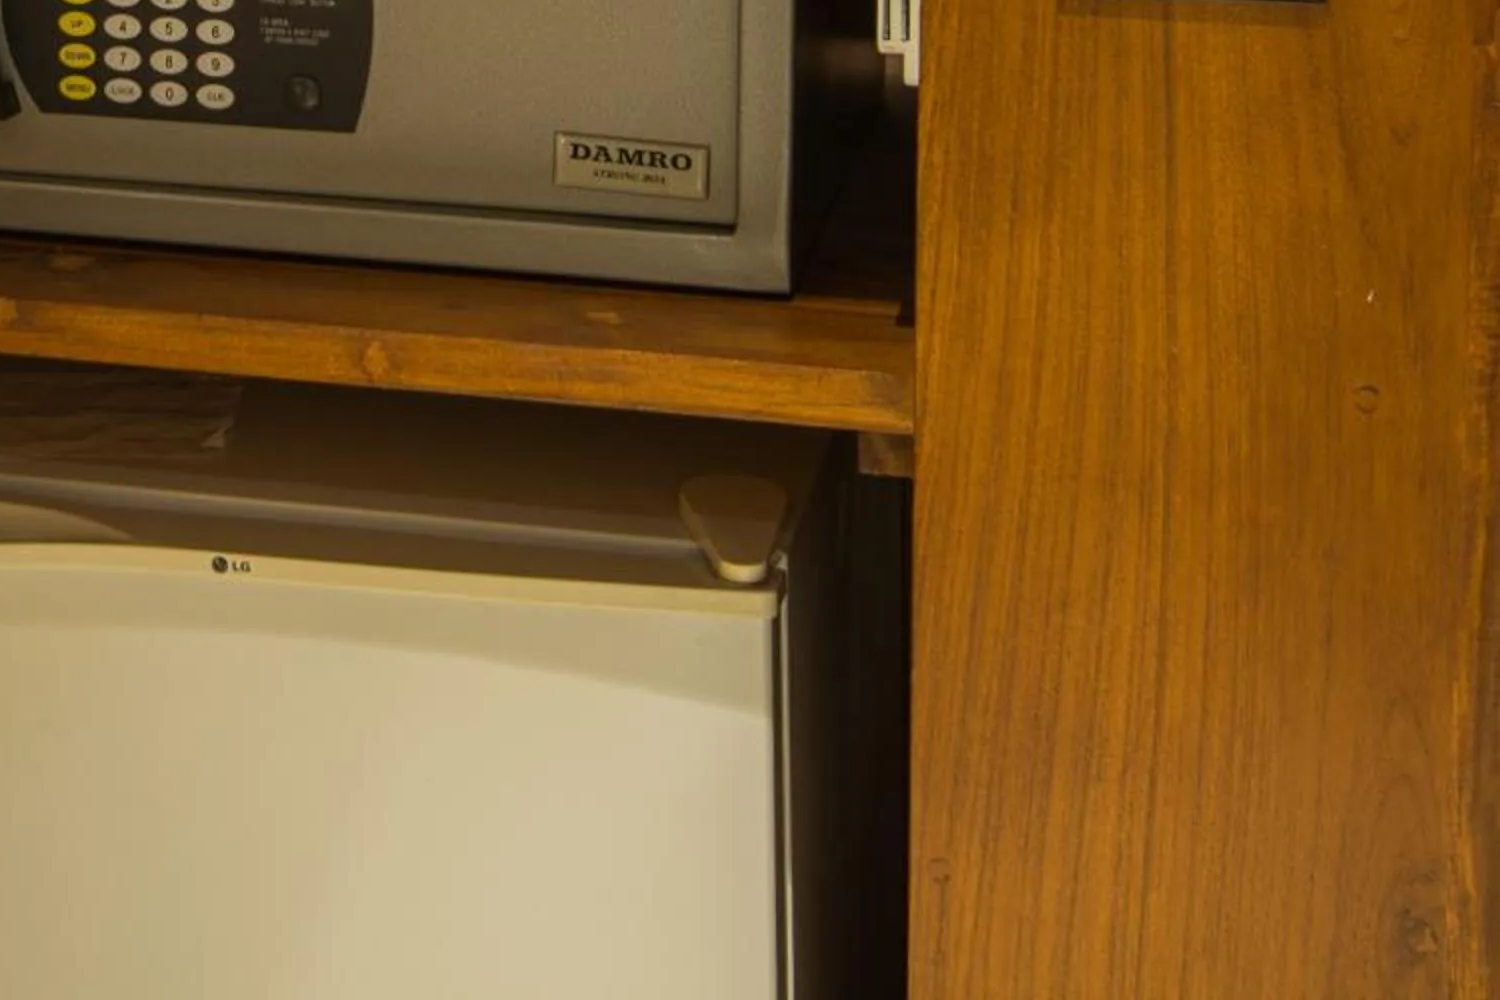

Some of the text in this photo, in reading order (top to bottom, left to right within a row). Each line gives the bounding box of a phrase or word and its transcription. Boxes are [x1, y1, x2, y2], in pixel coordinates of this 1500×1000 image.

[119, 21, 127, 33] 4
[165, 23, 173, 35] 5
[212, 26, 220, 38] 6
[119, 52, 127, 65] 7
[165, 56, 173, 68] 8
[211, 57, 220, 70] 9
[165, 87, 174, 99] 0
[570, 142, 693, 171] DAMRO
[232, 561, 251, 572] LG
